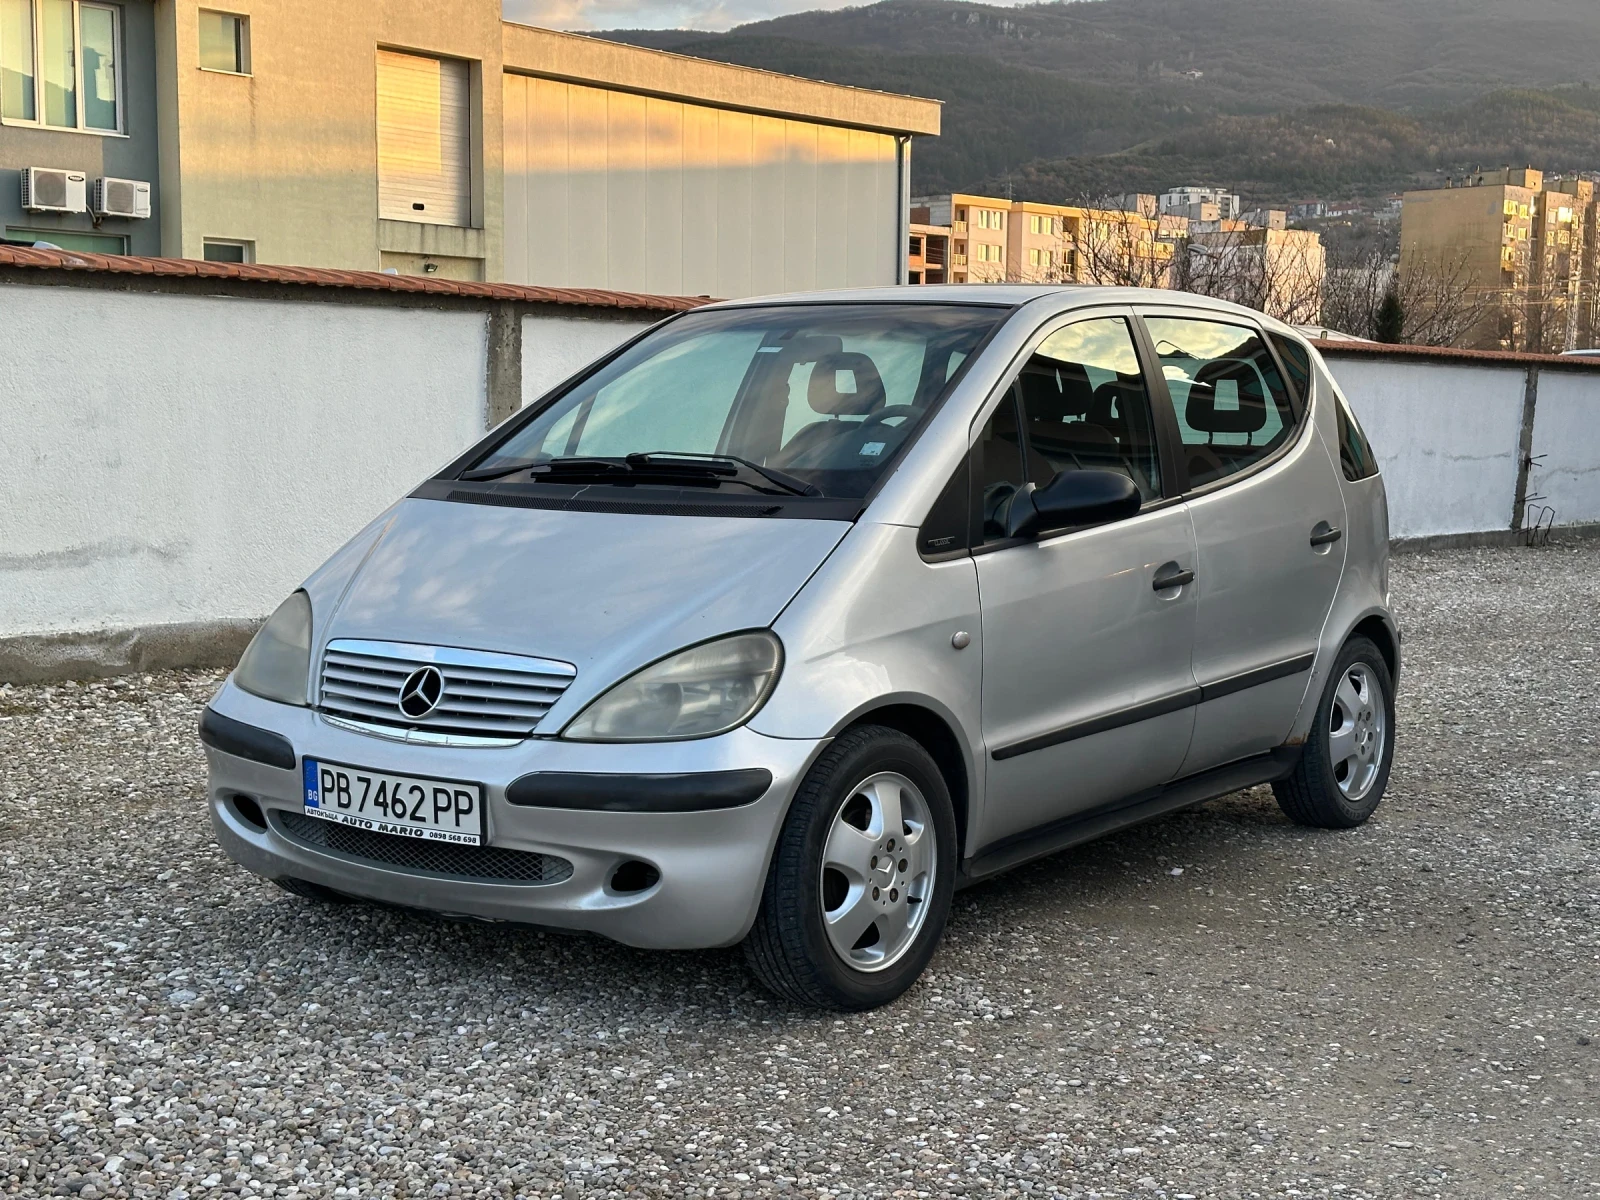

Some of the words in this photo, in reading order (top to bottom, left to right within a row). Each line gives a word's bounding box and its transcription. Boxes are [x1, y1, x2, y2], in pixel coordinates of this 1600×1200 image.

[308, 789, 318, 802] BG
[321, 768, 352, 808] PB
[357, 776, 427, 822] 7462
[432, 787, 474, 827] PP
[341, 815, 373, 829] AUTO
[377, 823, 424, 837] MARIO
[429, 831, 447, 840] 0898
[448, 834, 461, 842] 568
[463, 836, 477, 844] 698
